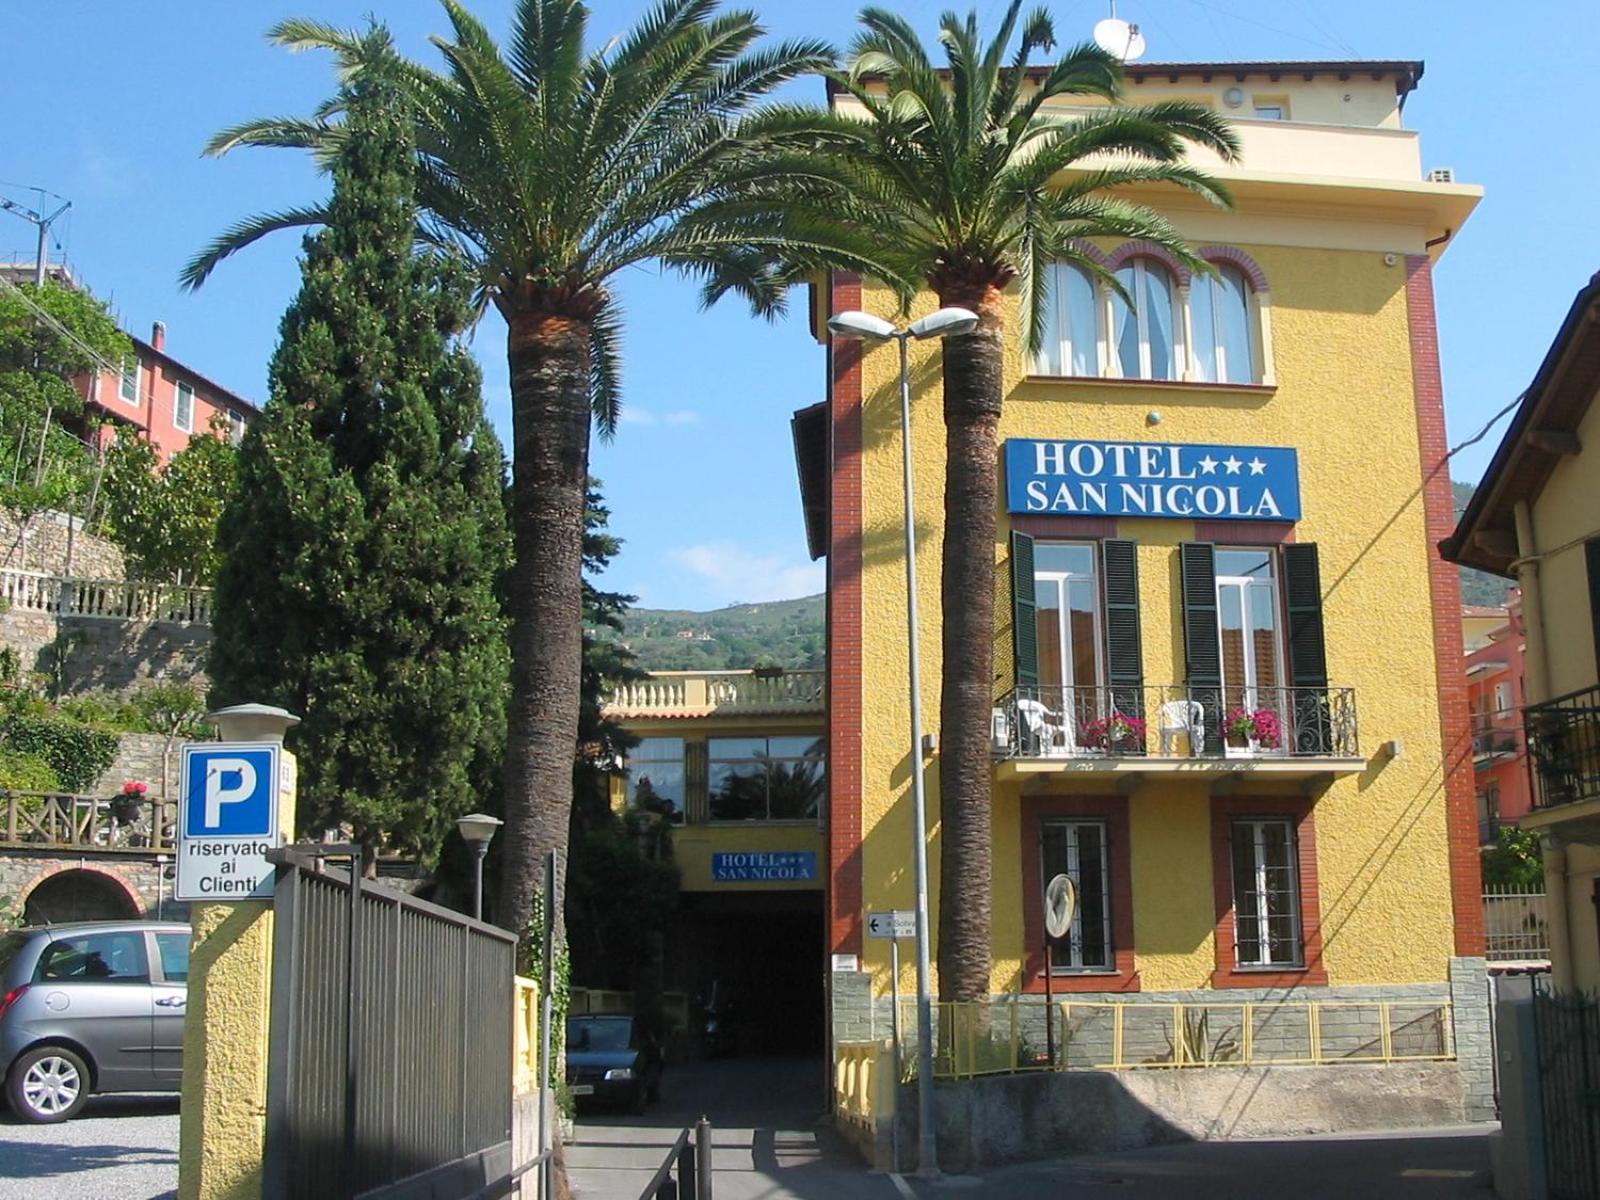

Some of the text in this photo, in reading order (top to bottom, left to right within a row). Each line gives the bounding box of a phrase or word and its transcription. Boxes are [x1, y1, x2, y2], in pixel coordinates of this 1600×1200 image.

[1034, 442, 1197, 479] HOTEL
[1026, 480, 1282, 517] SAN NICOLA
[205, 758, 257, 828] P
[189, 840, 269, 856] riservato
[220, 859, 236, 874] ai
[721, 853, 780, 867] HOTEL
[718, 867, 810, 879] SAN NICOLA
[199, 876, 257, 892] Clienti
